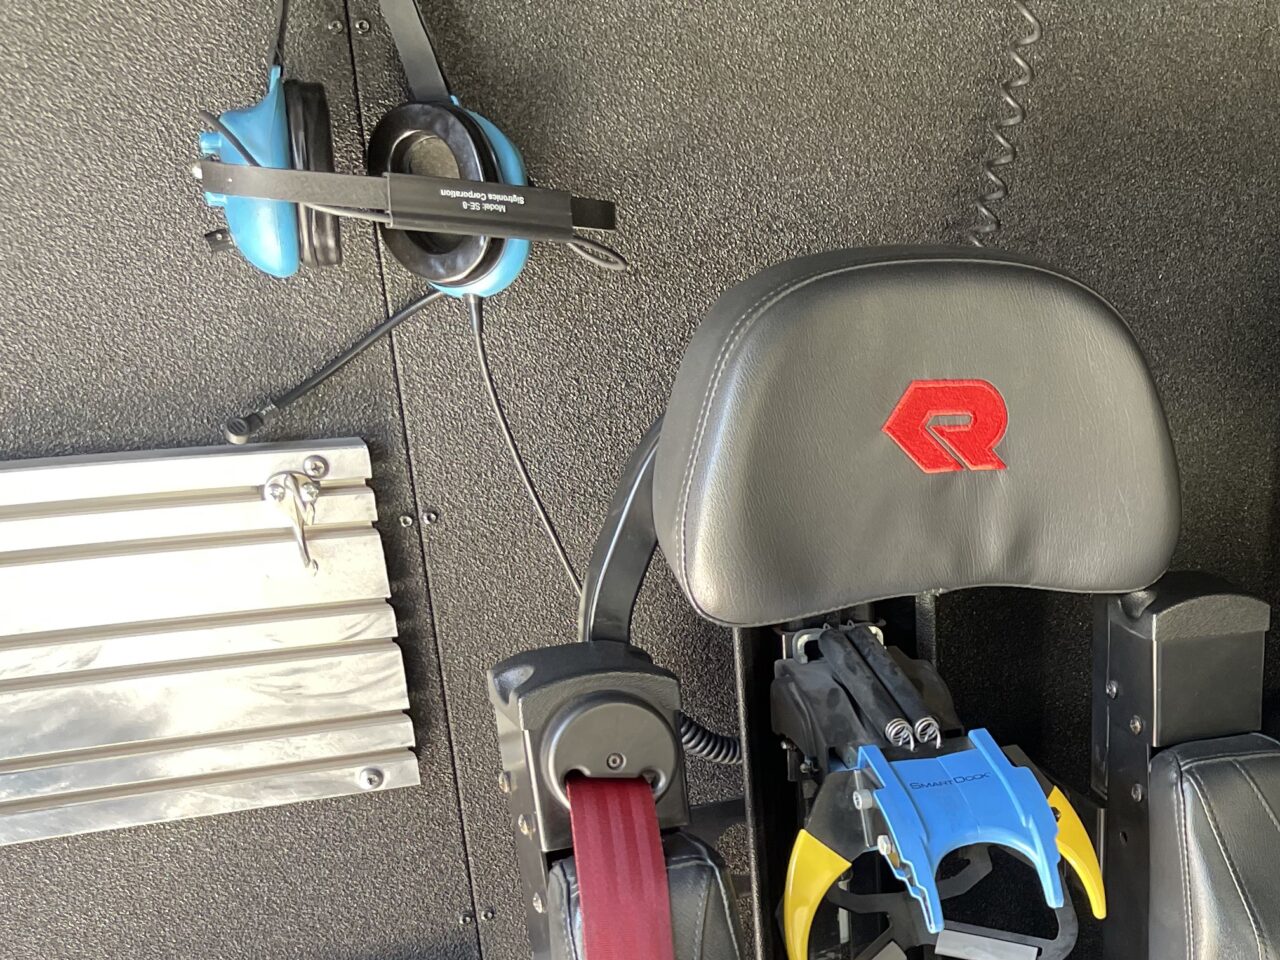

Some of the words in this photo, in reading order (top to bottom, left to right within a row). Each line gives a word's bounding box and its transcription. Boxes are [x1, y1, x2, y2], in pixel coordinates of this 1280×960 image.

[441, 189, 487, 201] Corporation
[488, 193, 525, 205] Sigtronics
[482, 202, 506, 213] Model:
